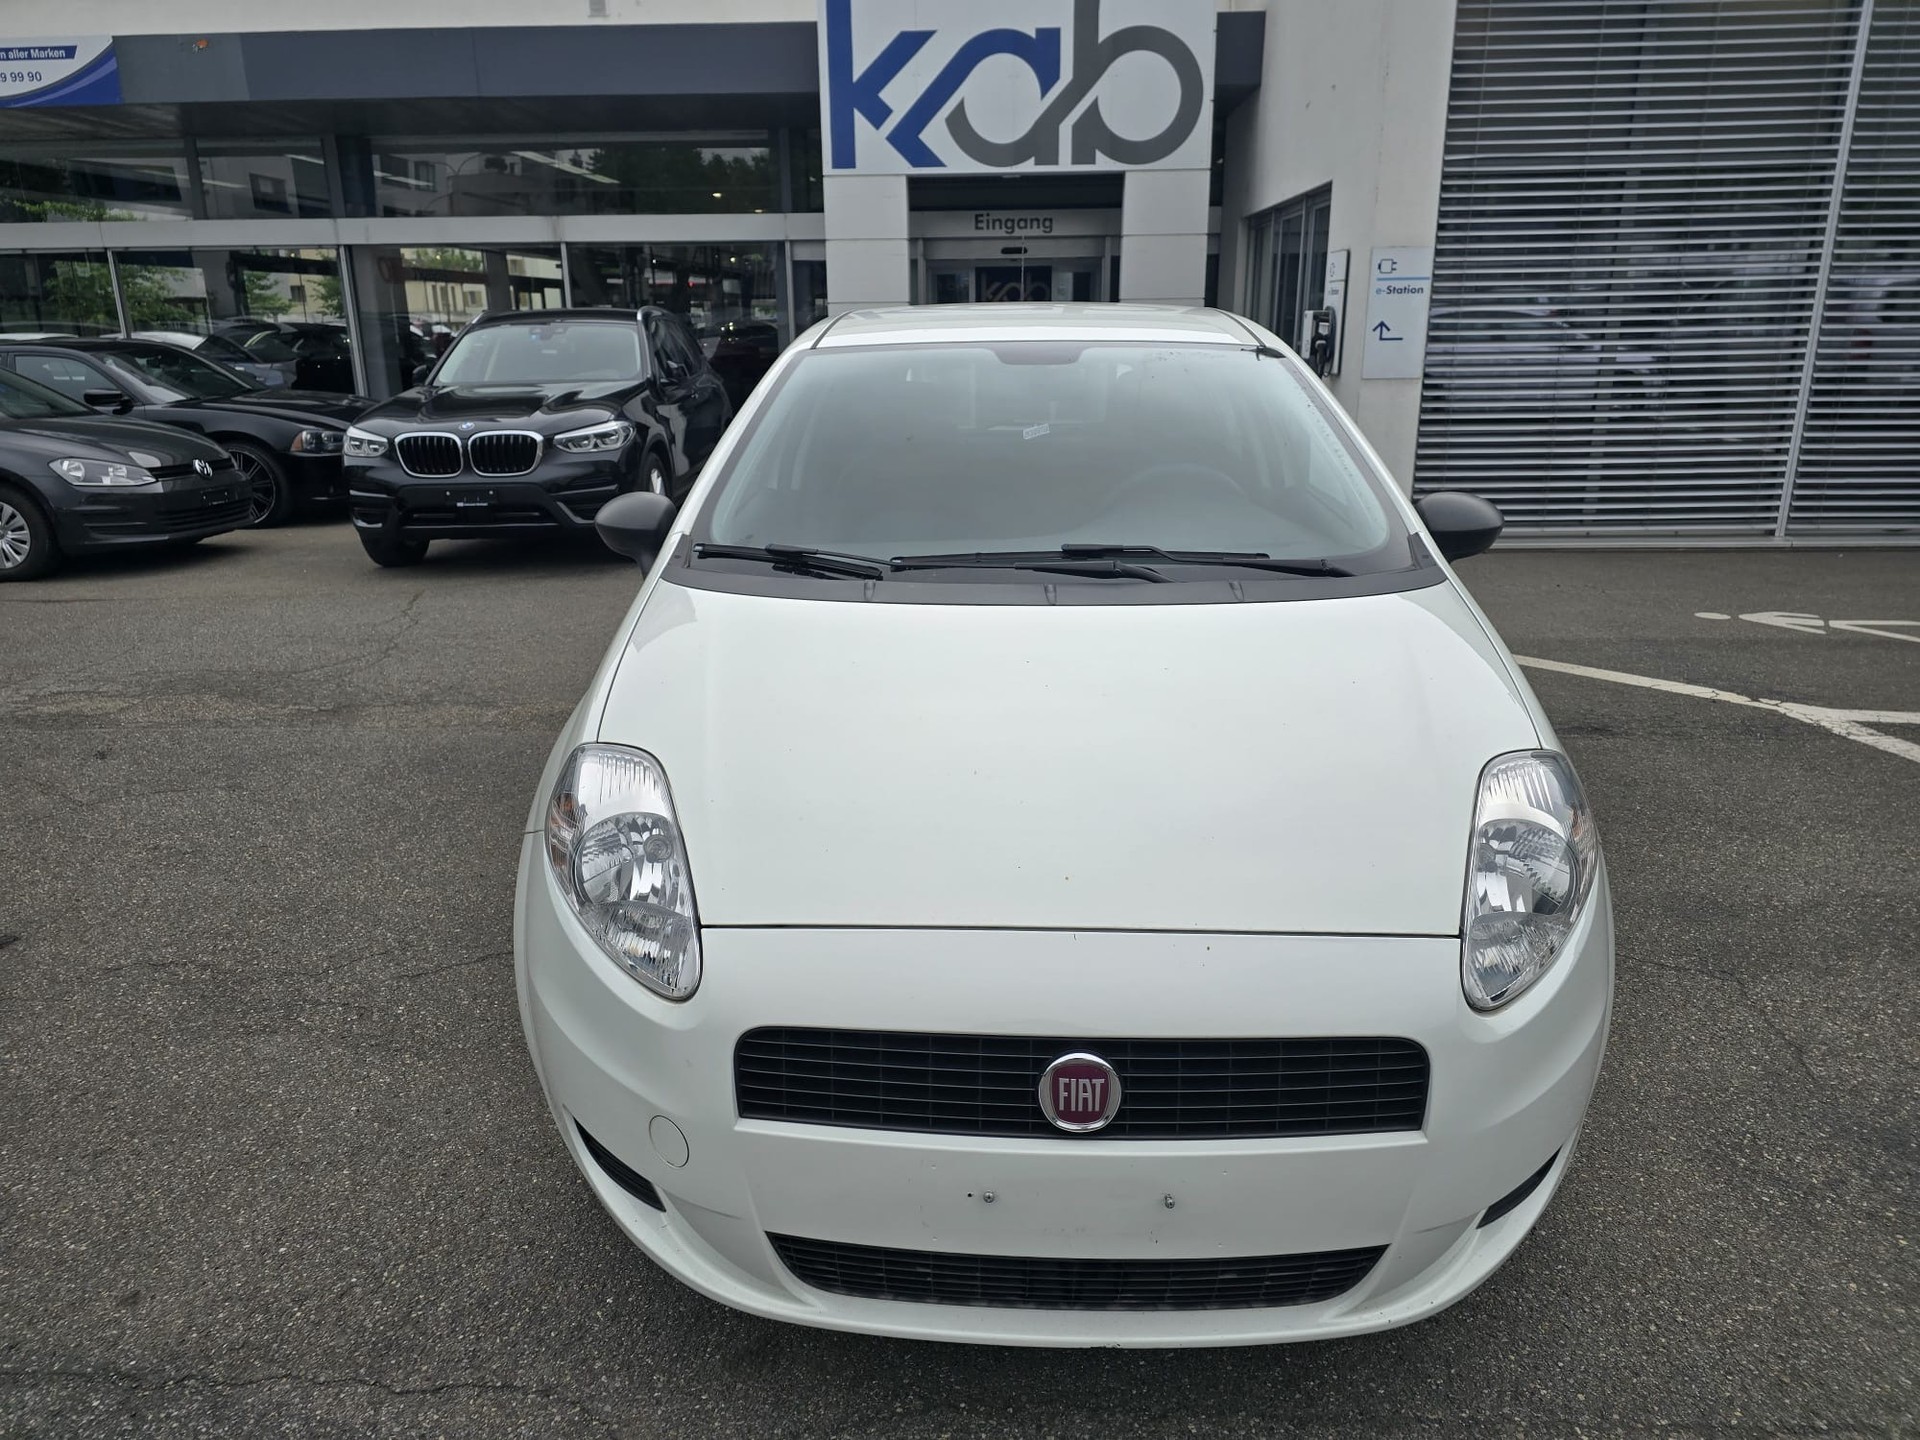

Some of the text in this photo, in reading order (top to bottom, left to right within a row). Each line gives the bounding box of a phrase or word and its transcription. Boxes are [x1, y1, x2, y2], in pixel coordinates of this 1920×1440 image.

[8, 49, 28, 59] aller
[30, 48, 66, 59] Marken
[10, 71, 25, 82] 99
[27, 71, 42, 82] 90
[826, 0, 1204, 169] kab
[974, 213, 1054, 234] Eingang
[1375, 284, 1424, 295] e-Station
[1058, 1077, 1105, 1112] FIAT
